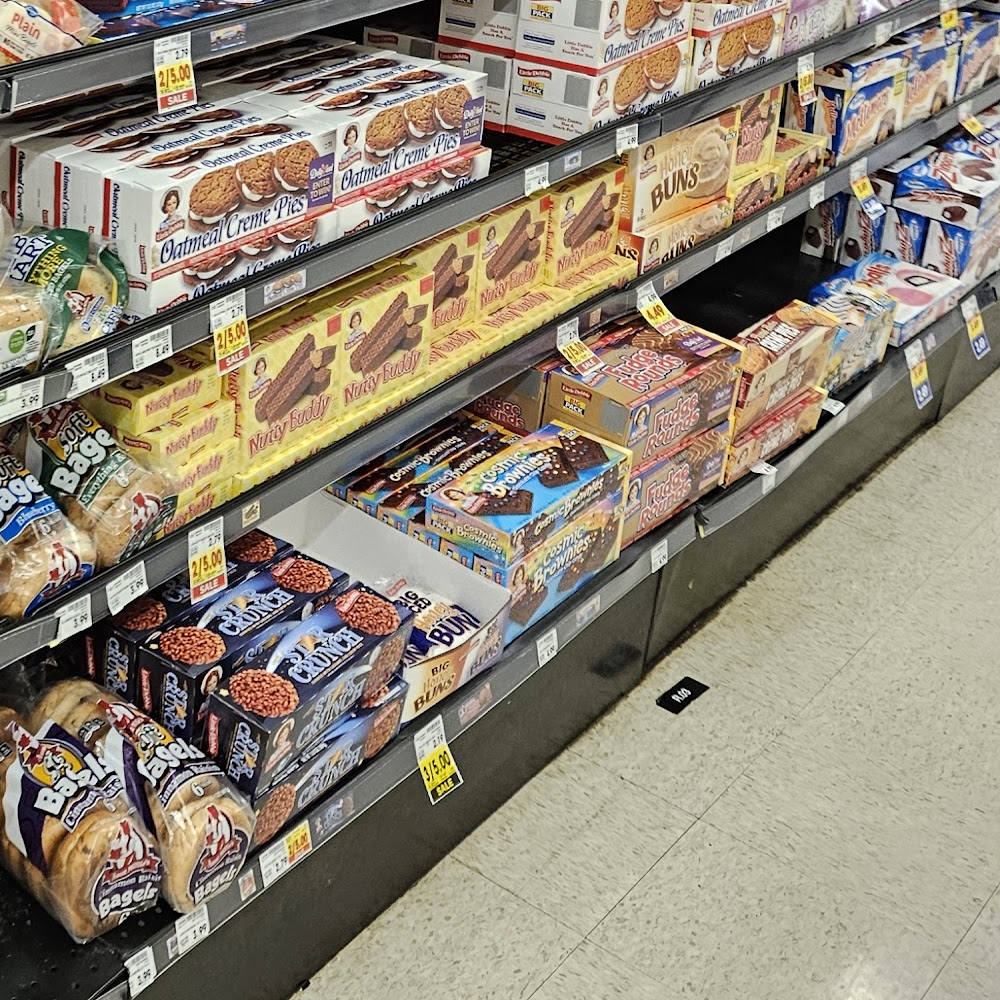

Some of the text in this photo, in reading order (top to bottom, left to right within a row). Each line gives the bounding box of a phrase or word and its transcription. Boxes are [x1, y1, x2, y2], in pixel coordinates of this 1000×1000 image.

[12, 13, 40, 39] Plain
[531, 10, 554, 20] PACK
[158, 65, 191, 88] 2/5.00
[523, 87, 544, 96] PACK
[167, 92, 189, 107] SALE
[340, 130, 461, 190] Oatmeal Creme Pies
[312, 178, 331, 190] ENTER
[651, 165, 700, 212] BUNS
[159, 193, 306, 265] Oatmeal Creme Pies
[480, 262, 539, 311] Nutty Buddy
[648, 305, 665, 322] 4.49
[216, 321, 246, 348] 2/5.00
[225, 351, 245, 366] SALE
[344, 350, 421, 405] Nutty Buddy
[249, 394, 331, 457] Nutty Buddy
[564, 403, 586, 416] PACK
[653, 393, 699, 436] Fudge
[57, 411, 93, 456] Soft
[643, 409, 700, 459] Rounds
[479, 451, 526, 485] Cosmic
[490, 453, 550, 498] Brownies
[646, 464, 690, 508] Fudge
[533, 476, 605, 536] Cosmic Brownies
[638, 482, 691, 534] Rounds
[456, 529, 503, 555] Brownies
[462, 523, 499, 541] Cosmic
[541, 525, 586, 565] Cosmic
[191, 552, 223, 579] 2/5.00
[532, 537, 590, 592] Brownies
[130, 579, 144, 595] 3.99
[74, 613, 89, 628] 3.99
[217, 587, 295, 637] CRUNCH
[288, 627, 364, 685] CRUNCH
[431, 660, 451, 677] BIG
[413, 681, 455, 713] BUNS
[422, 751, 452, 783] 3/5.00
[436, 778, 455, 797] SALE
[193, 864, 238, 904] Bagels
[98, 883, 159, 920] Bagels
